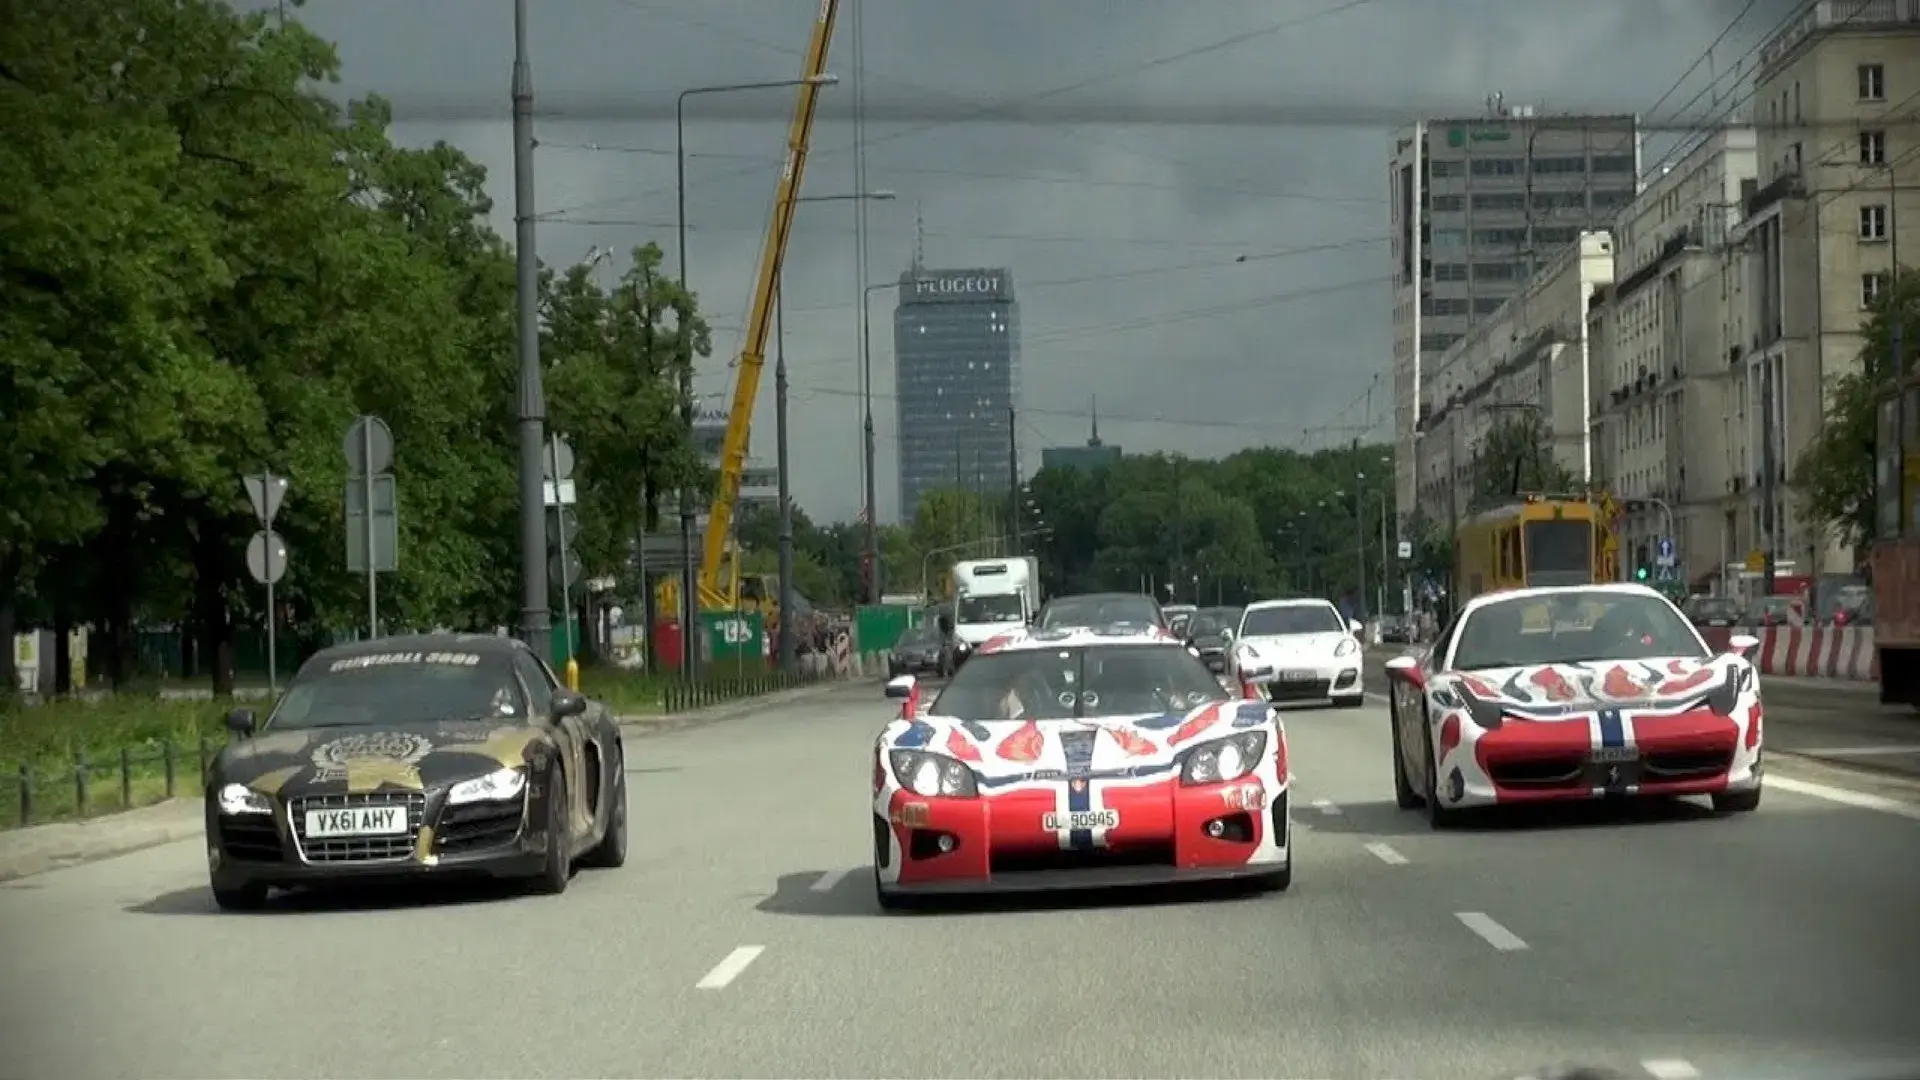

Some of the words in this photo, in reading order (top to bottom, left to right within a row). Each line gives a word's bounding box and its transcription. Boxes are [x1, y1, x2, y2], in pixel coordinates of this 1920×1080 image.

[916, 277, 999, 292] PEUGEOT
[318, 811, 356, 832] VX61
[362, 809, 395, 829] AHY
[1071, 811, 1115, 826] 90945
